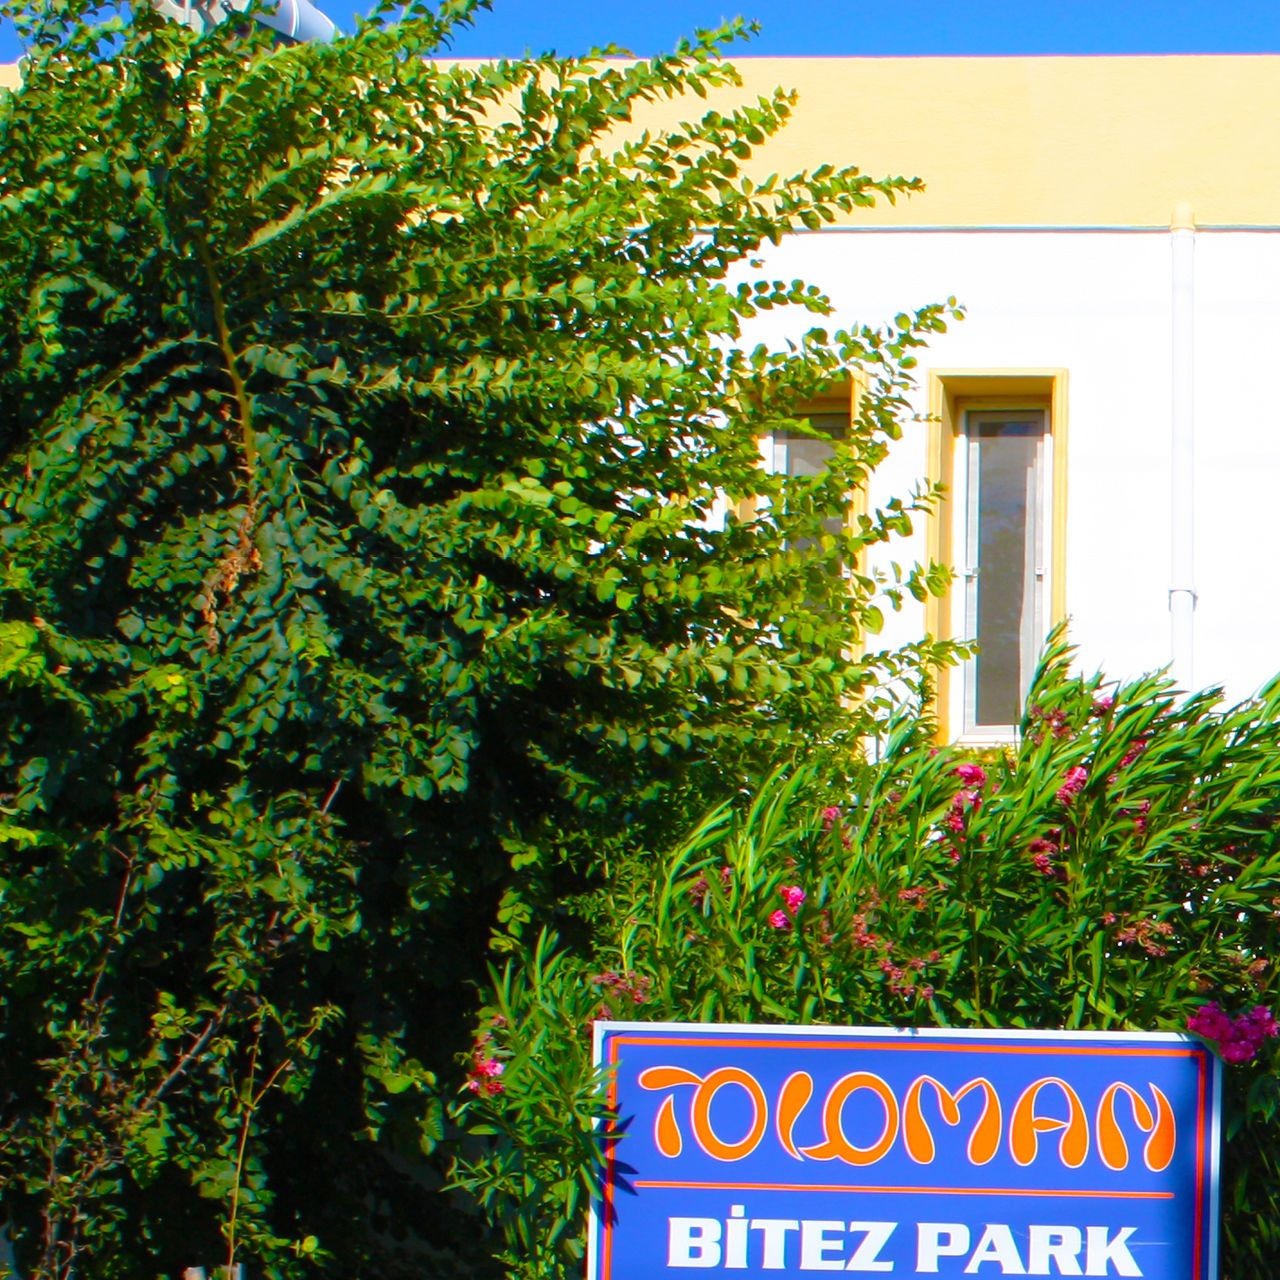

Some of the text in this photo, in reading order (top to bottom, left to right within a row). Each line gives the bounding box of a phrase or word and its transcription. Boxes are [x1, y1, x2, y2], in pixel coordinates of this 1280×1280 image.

[638, 1066, 1175, 1171] TOLOMAN
[667, 1205, 1143, 1277] BİTEZ PARK
